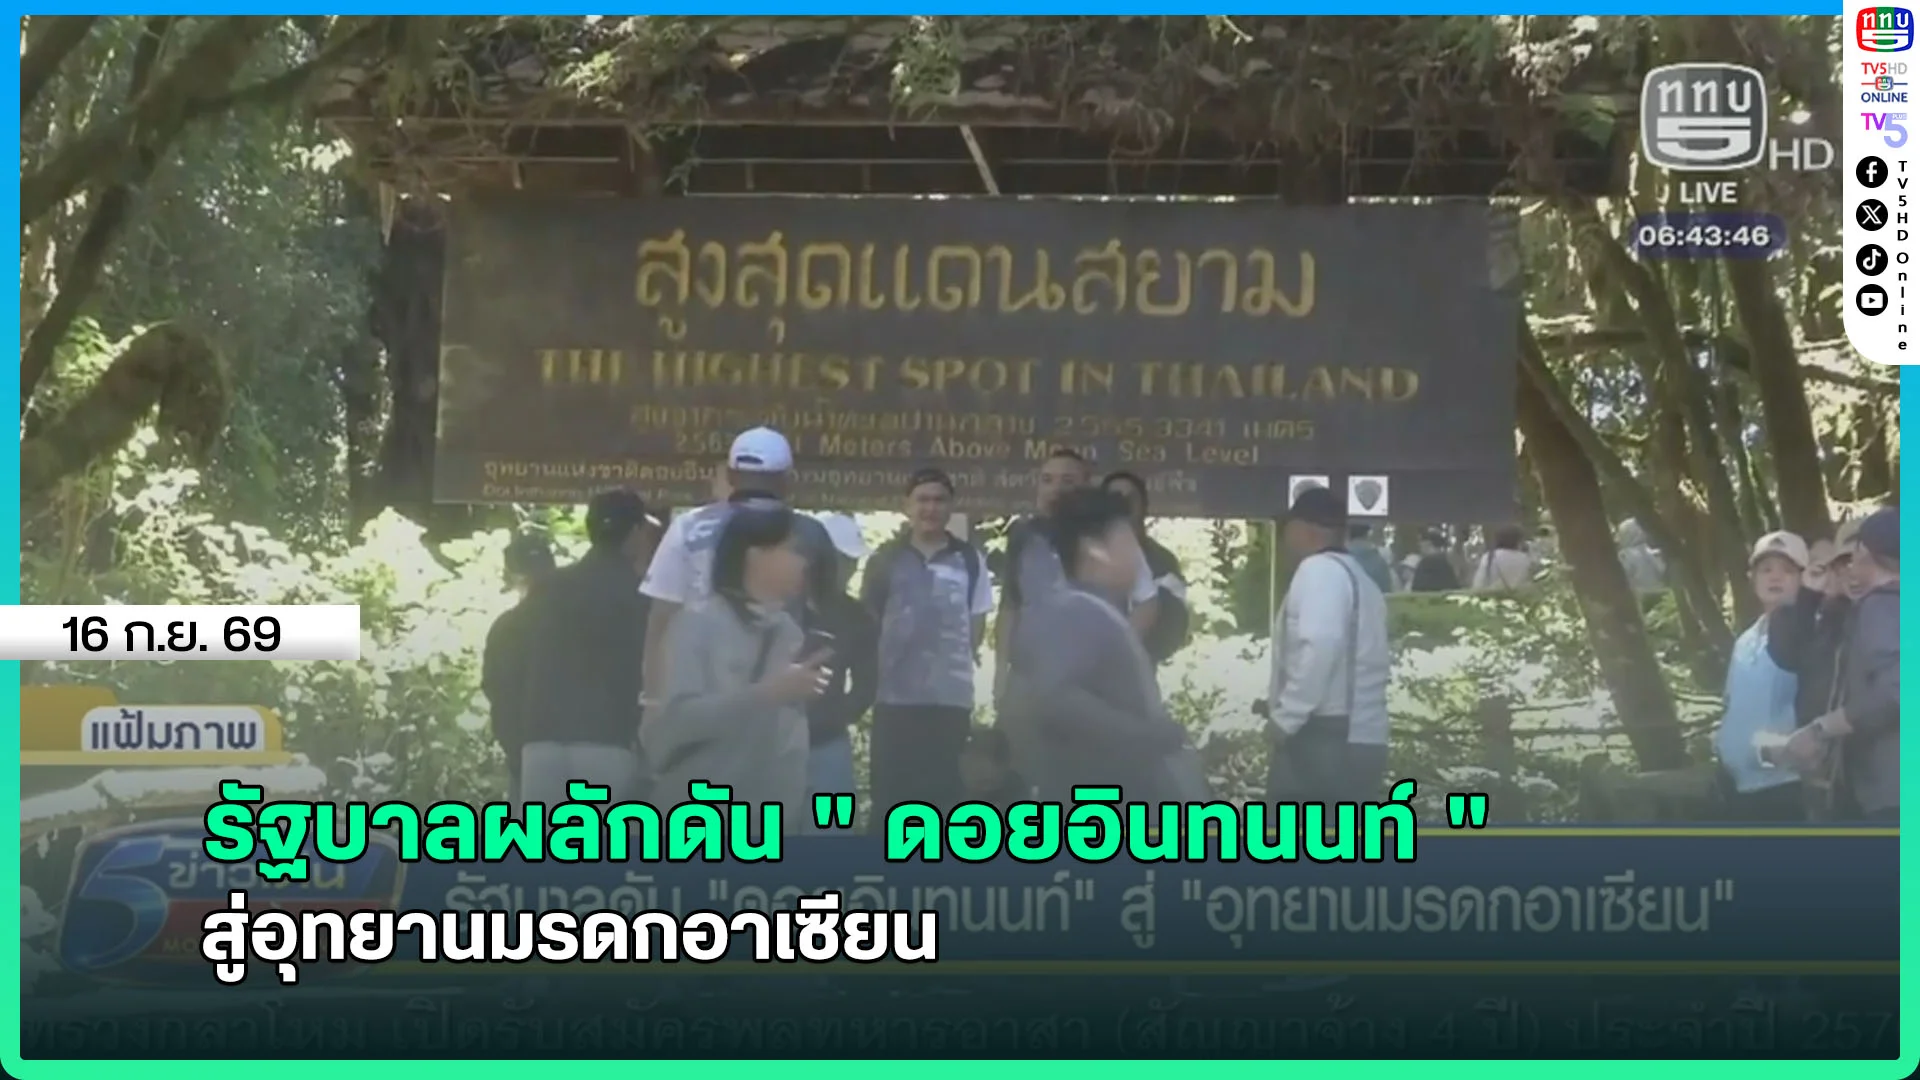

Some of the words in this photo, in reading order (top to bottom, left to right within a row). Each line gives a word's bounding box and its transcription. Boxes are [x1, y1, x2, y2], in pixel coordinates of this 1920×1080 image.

[635, 229, 1317, 343] สูงสุดแดนสยาม
[652, 350, 887, 392] HIGHEST
[899, 354, 1041, 396] SPOT
[1060, 360, 1114, 396] IN
[1134, 361, 1420, 401] THAILAND
[818, 432, 913, 458] Meters
[930, 436, 1011, 459] Above
[1118, 440, 1167, 463] Sea
[1186, 441, 1260, 465] Level
